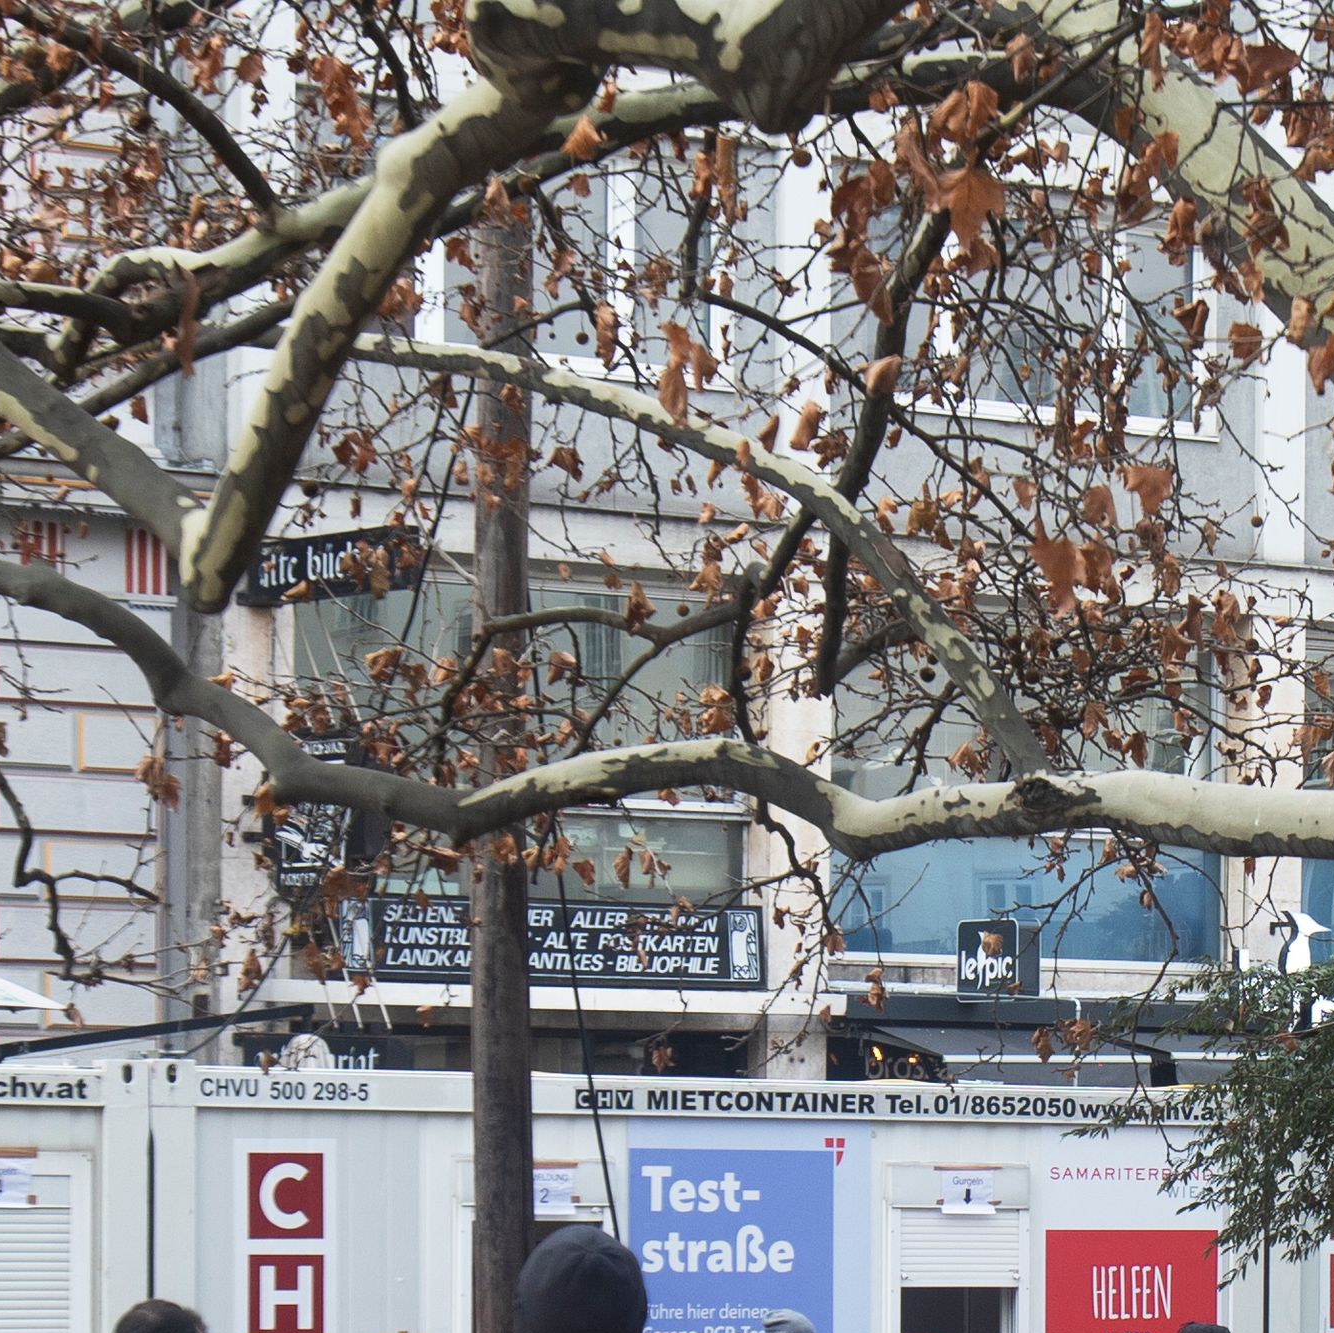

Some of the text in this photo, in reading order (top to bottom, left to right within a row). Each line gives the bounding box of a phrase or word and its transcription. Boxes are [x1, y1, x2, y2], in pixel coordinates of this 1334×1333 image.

[570, 910, 628, 930] ALLER
[598, 932, 719, 954] POSTKARTEN
[200, 1078, 369, 1101] CHVU 500 298-5
[575, 1089, 875, 1113] CHV MIETCONTAINER
[885, 1094, 929, 1115] Tel.
[934, 1095, 1076, 1117] 01/8652050
[539, 1187, 550, 1204] 2
[641, 1165, 761, 1213] Test-
[641, 1224, 795, 1273] straße
[1092, 1264, 1173, 1321] HELFEN
[687, 1303, 717, 1320] hier
